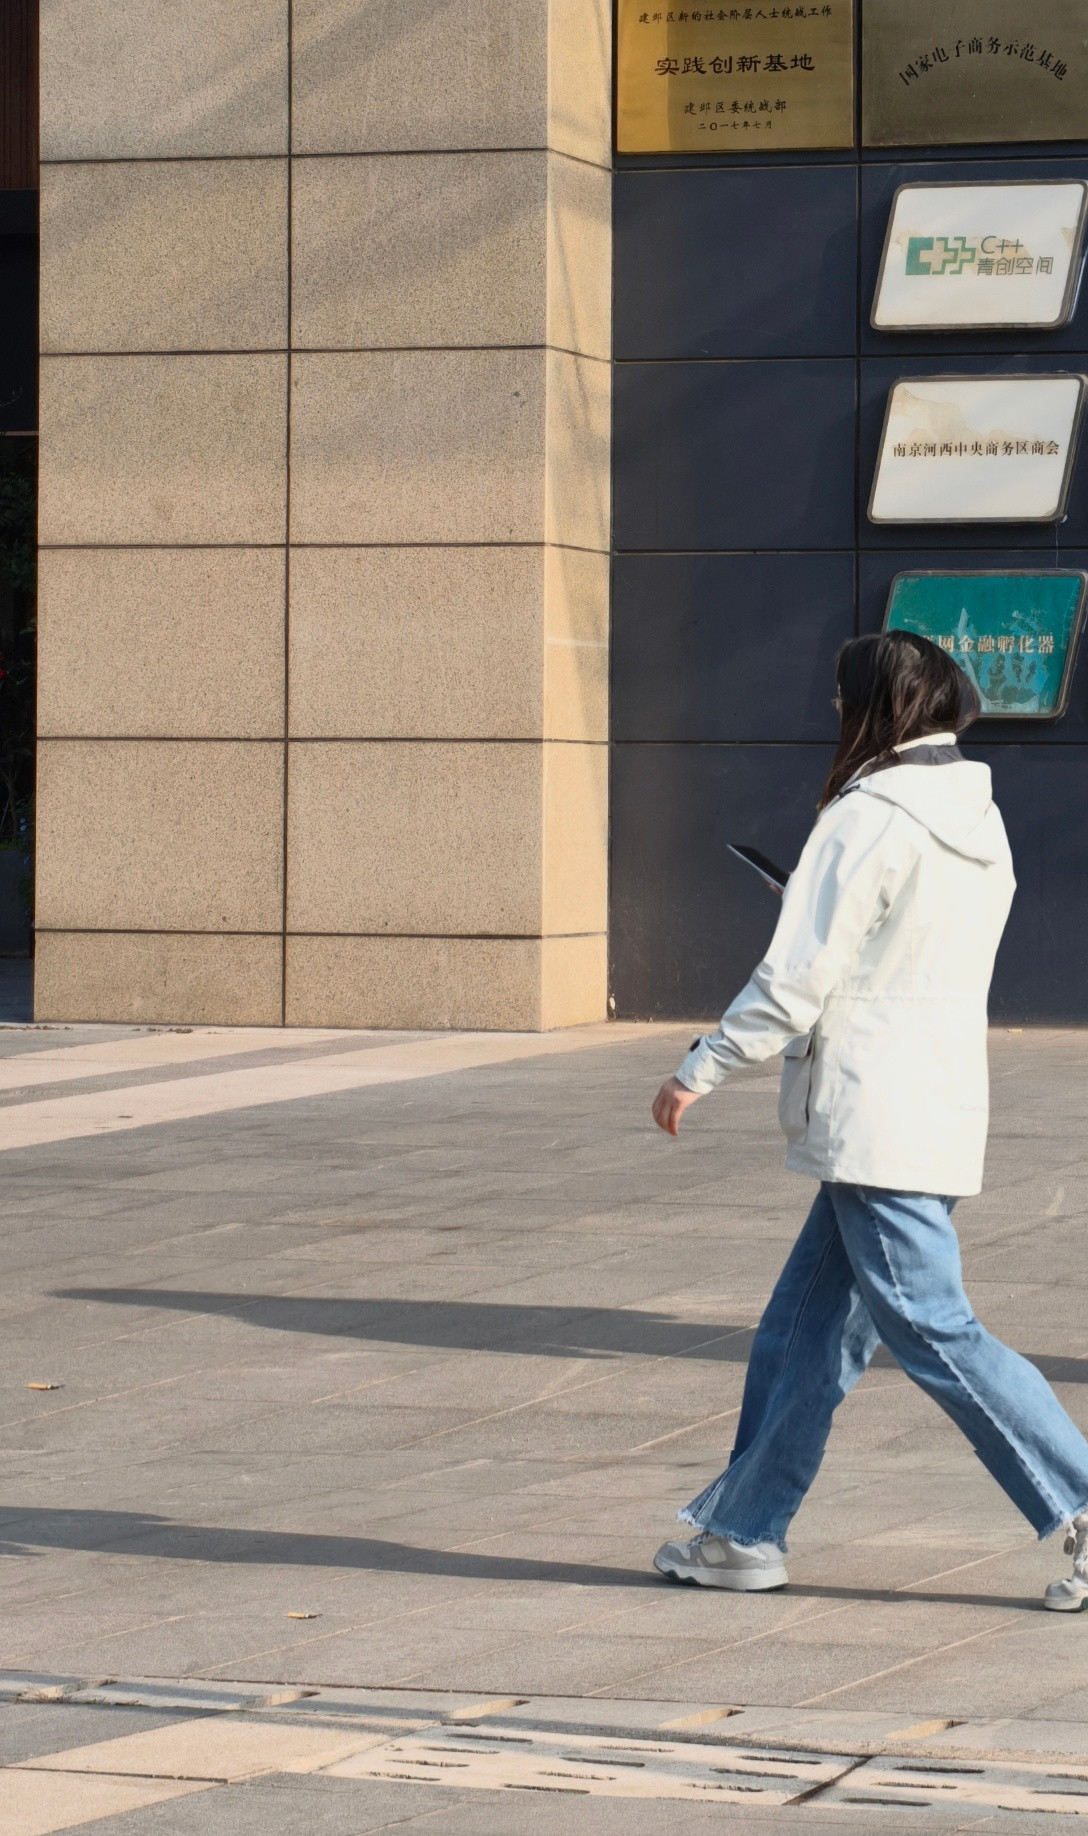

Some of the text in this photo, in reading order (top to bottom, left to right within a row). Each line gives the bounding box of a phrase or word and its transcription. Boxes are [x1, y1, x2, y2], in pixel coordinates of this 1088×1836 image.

[638, 5, 833, 24] 建邺区新的社会阶层人士统战工作
[654, 53, 816, 76] 实践创新基地
[899, 36, 1068, 86] 国家电子商务示范基地
[683, 99, 787, 115] 建邺区委统战部
[981, 236, 1024, 254] C++
[977, 256, 1054, 276] 青创空间
[893, 440, 1060, 457] 南京河西中央商务区商会
